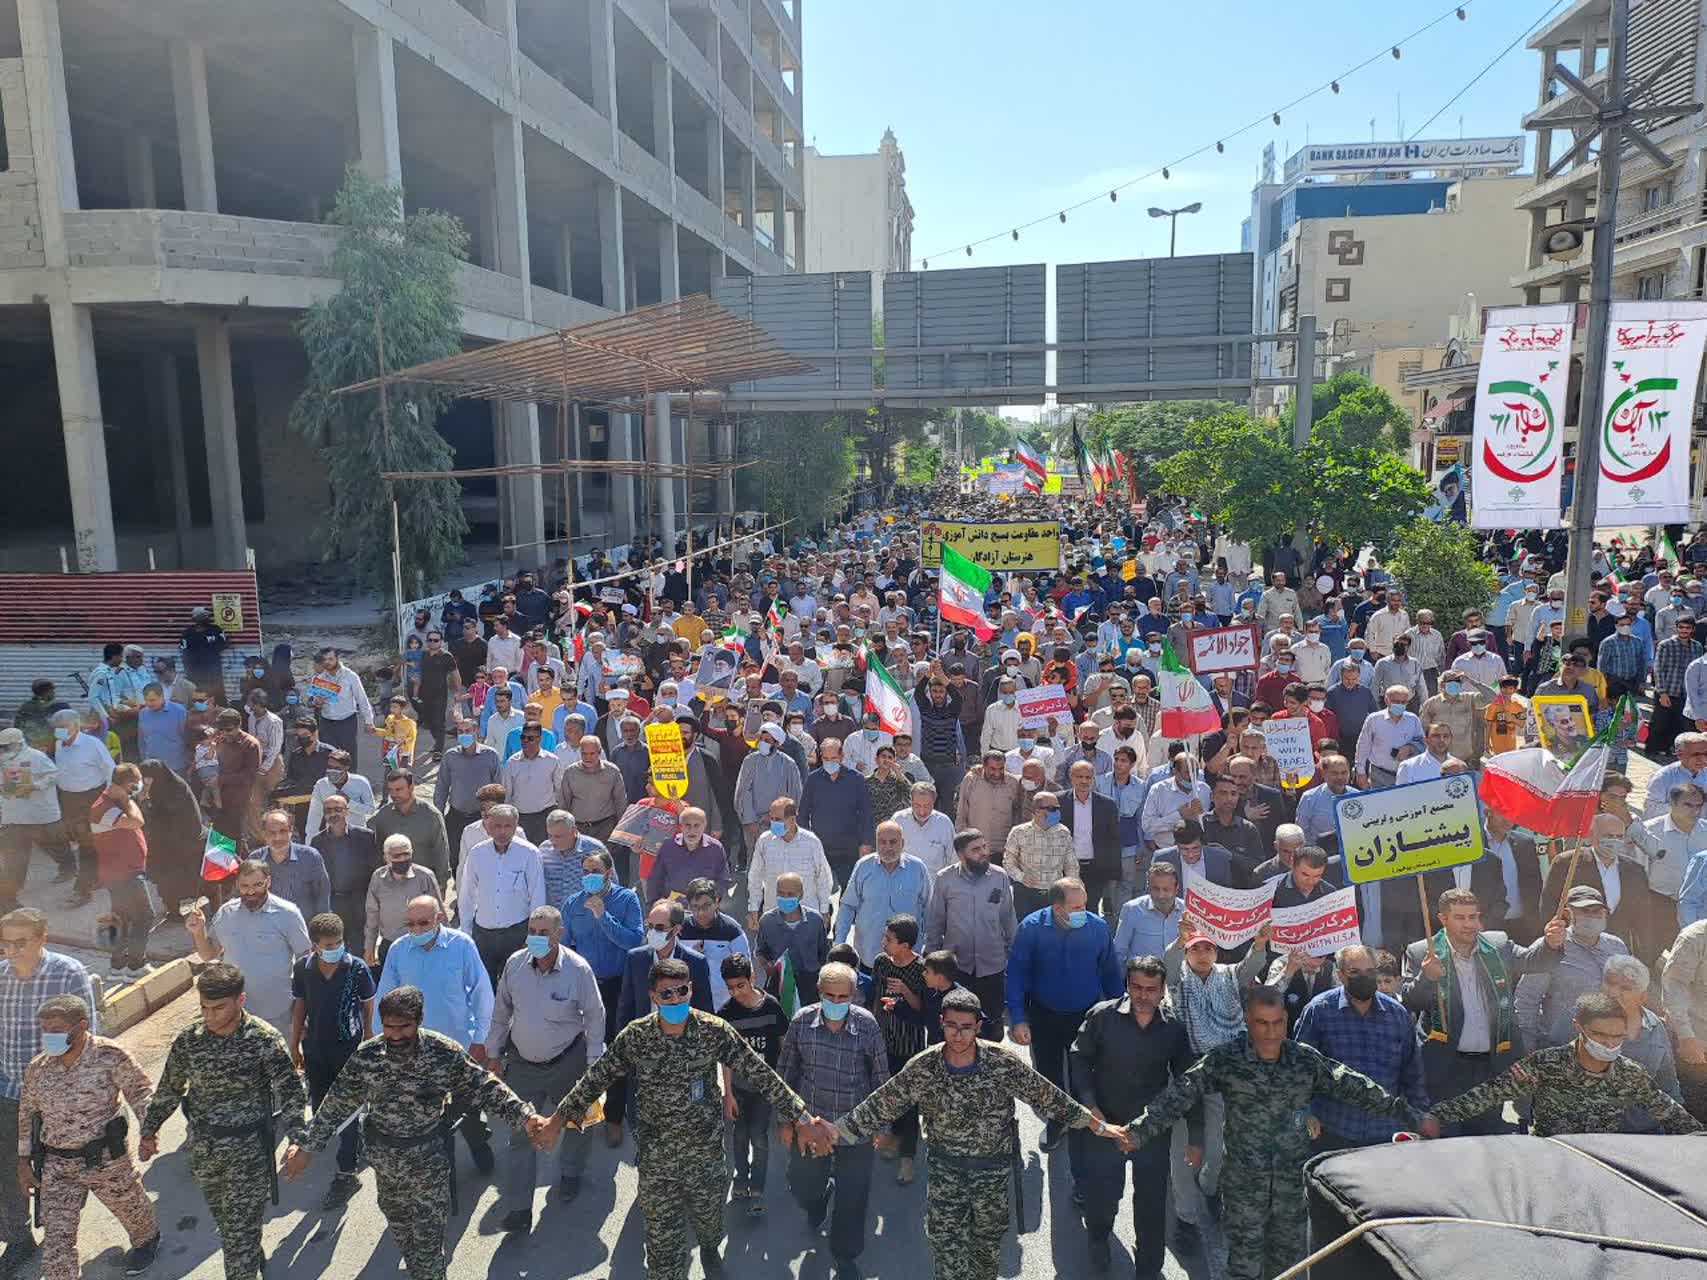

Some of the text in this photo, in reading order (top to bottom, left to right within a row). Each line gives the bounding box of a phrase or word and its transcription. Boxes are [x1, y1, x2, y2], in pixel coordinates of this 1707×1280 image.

[1310, 147, 1401, 161] BANK SADERAT IRAN
[1422, 137, 1519, 158] بانک صادرات ایران
[1663, 322, 1686, 343] مرگ
[1648, 410, 1671, 433] ۱۳
[943, 527, 1060, 542] واحد مقاومت بسیج دانش آموزی
[1001, 551, 1034, 565] هنرستان
[1396, 805, 1427, 823] آموزشی
[1429, 803, 1454, 815] مجتمع
[1362, 814, 1387, 828] تربیتی
[1355, 823, 1472, 867] پیشتازان
[1224, 918, 1245, 927] بر
[1246, 907, 1270, 923] مرگ
[1276, 914, 1354, 942] مرگ بر امریکا
[1307, 938, 1332, 950] WITH
